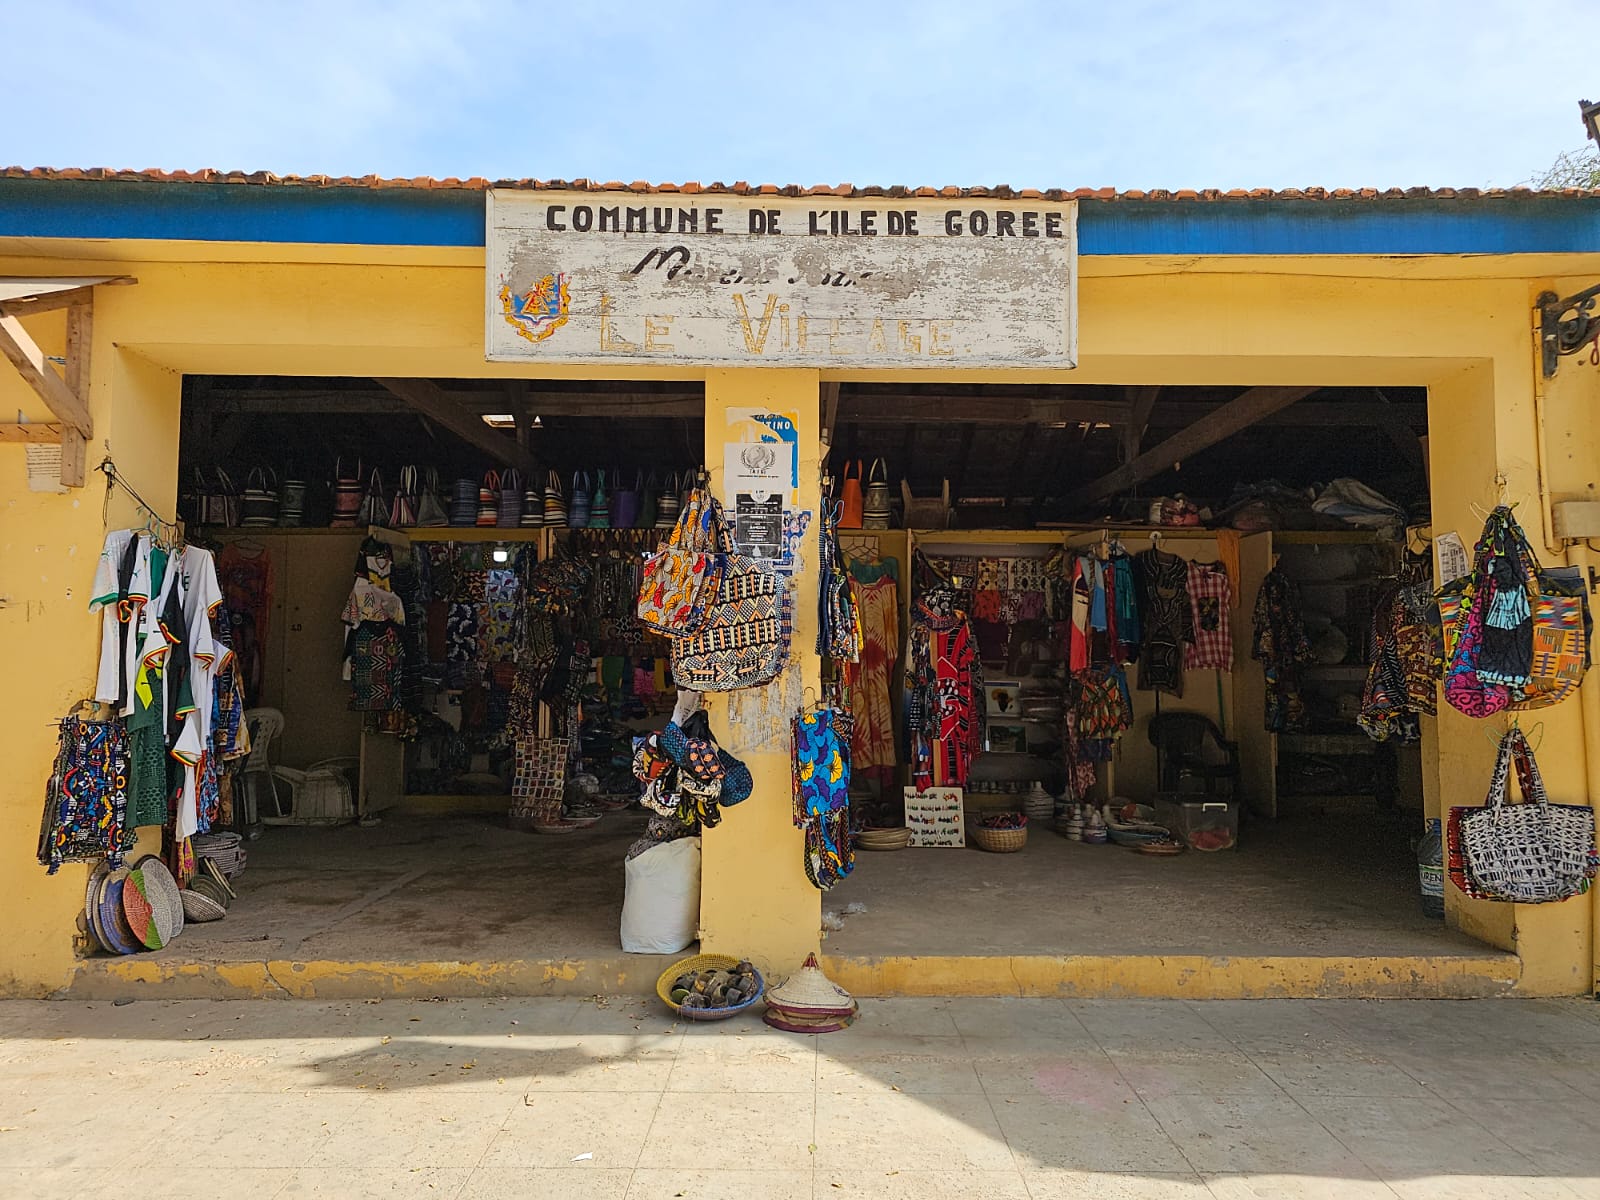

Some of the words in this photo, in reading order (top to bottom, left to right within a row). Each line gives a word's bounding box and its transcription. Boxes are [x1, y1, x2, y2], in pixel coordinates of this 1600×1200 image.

[546, 205, 724, 234] COMMUNE
[749, 209, 782, 235] DE
[808, 210, 877, 236] L'ILE
[887, 210, 919, 236] DE
[944, 210, 1063, 238] GOREE
[600, 294, 675, 352] LE
